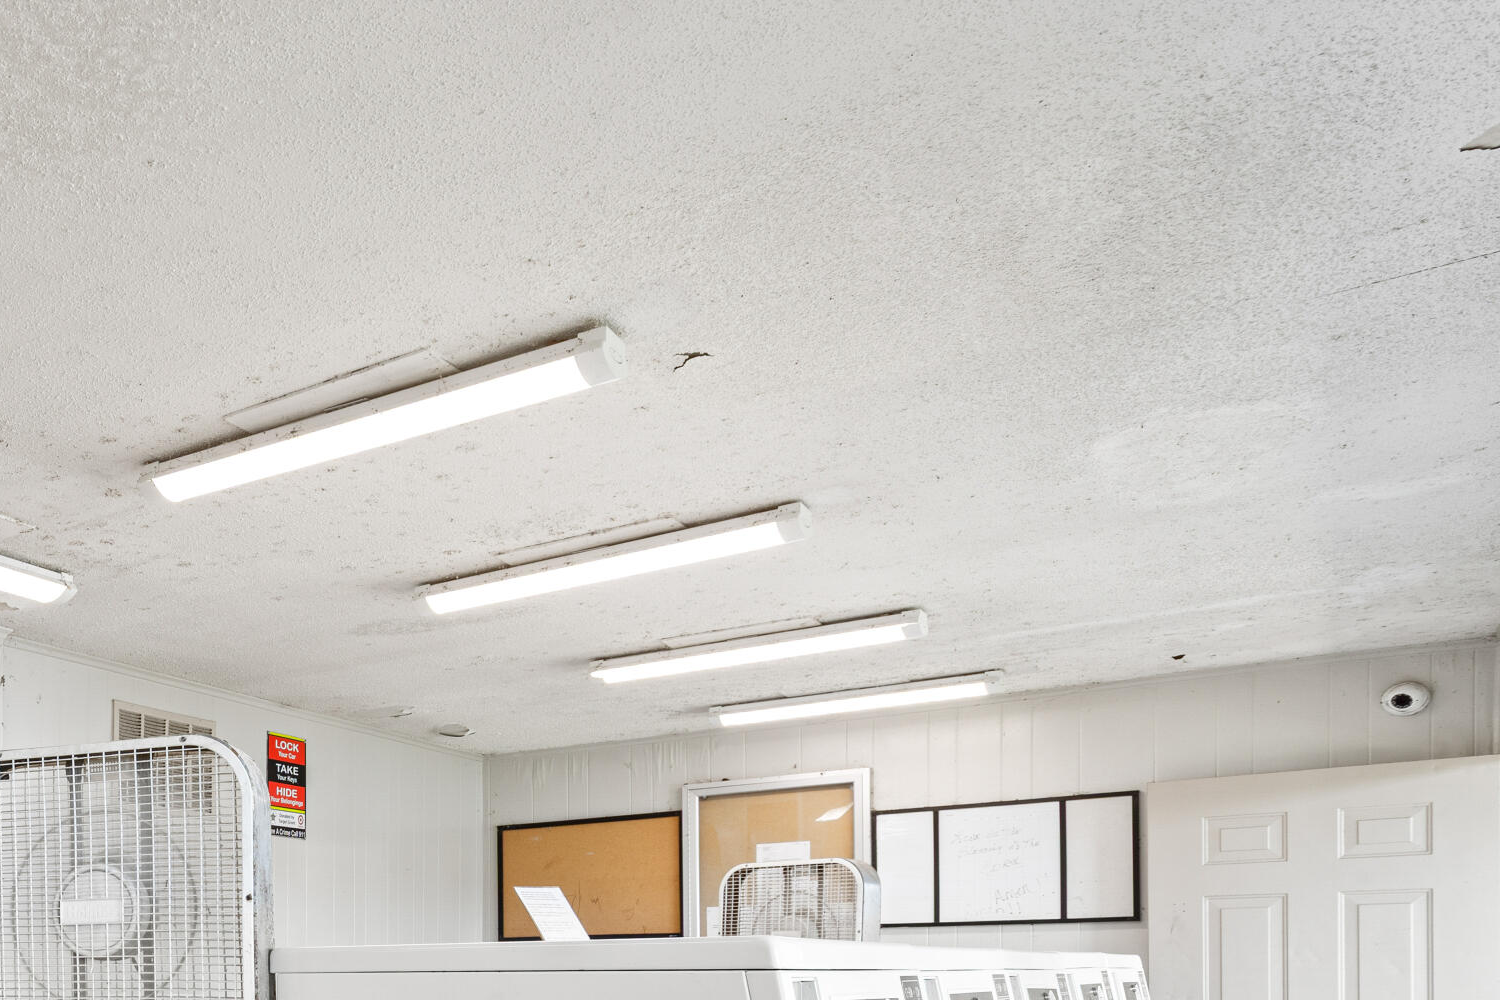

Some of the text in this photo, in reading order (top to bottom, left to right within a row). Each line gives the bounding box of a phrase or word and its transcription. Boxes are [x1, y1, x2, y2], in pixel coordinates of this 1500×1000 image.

[275, 739, 300, 753] LOCK
[276, 763, 299, 776] TAKE
[276, 786, 298, 799] HIDE
